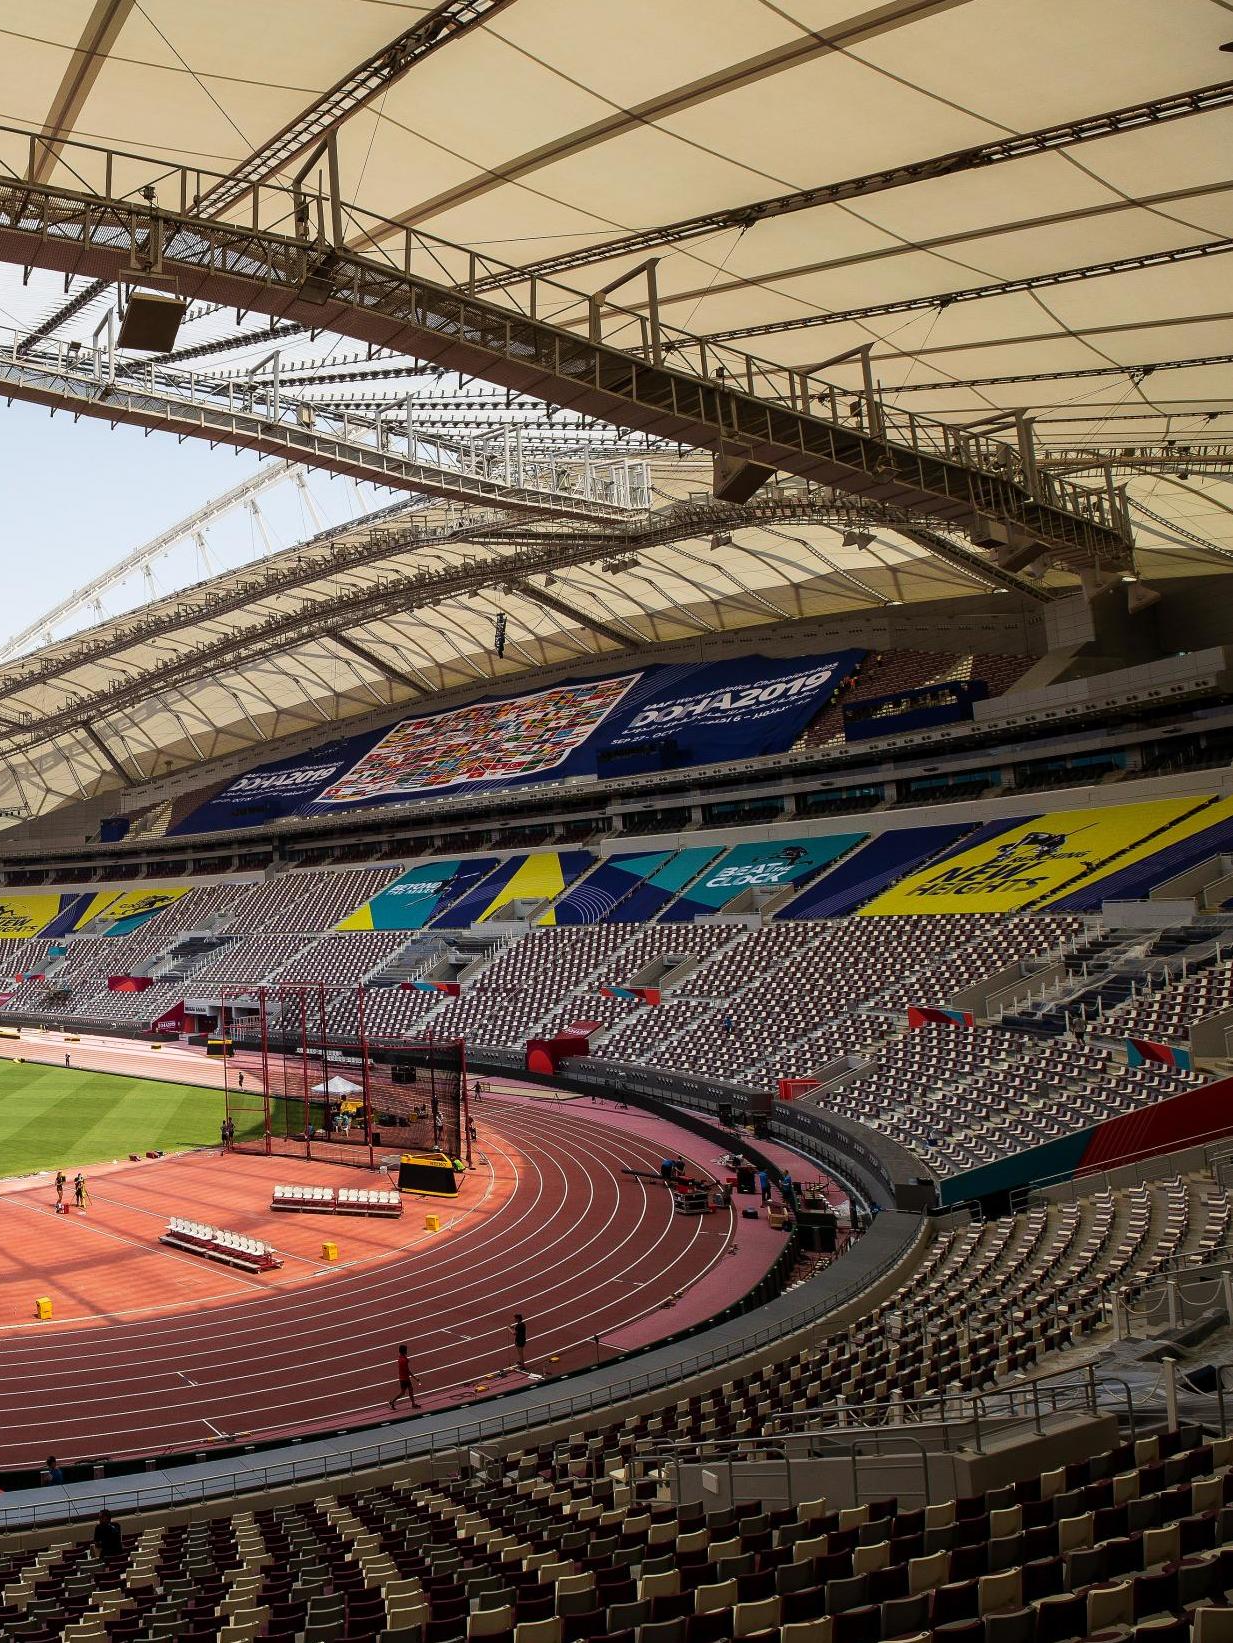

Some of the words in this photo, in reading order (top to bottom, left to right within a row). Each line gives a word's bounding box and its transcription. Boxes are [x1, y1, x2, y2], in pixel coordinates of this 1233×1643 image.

[627, 670, 832, 728] DOHA2019
[705, 871, 787, 888] CLOCK
[716, 863, 784, 878] BEAT
[925, 861, 1048, 883] NEW
[904, 877, 1050, 897] HEIGHTS
